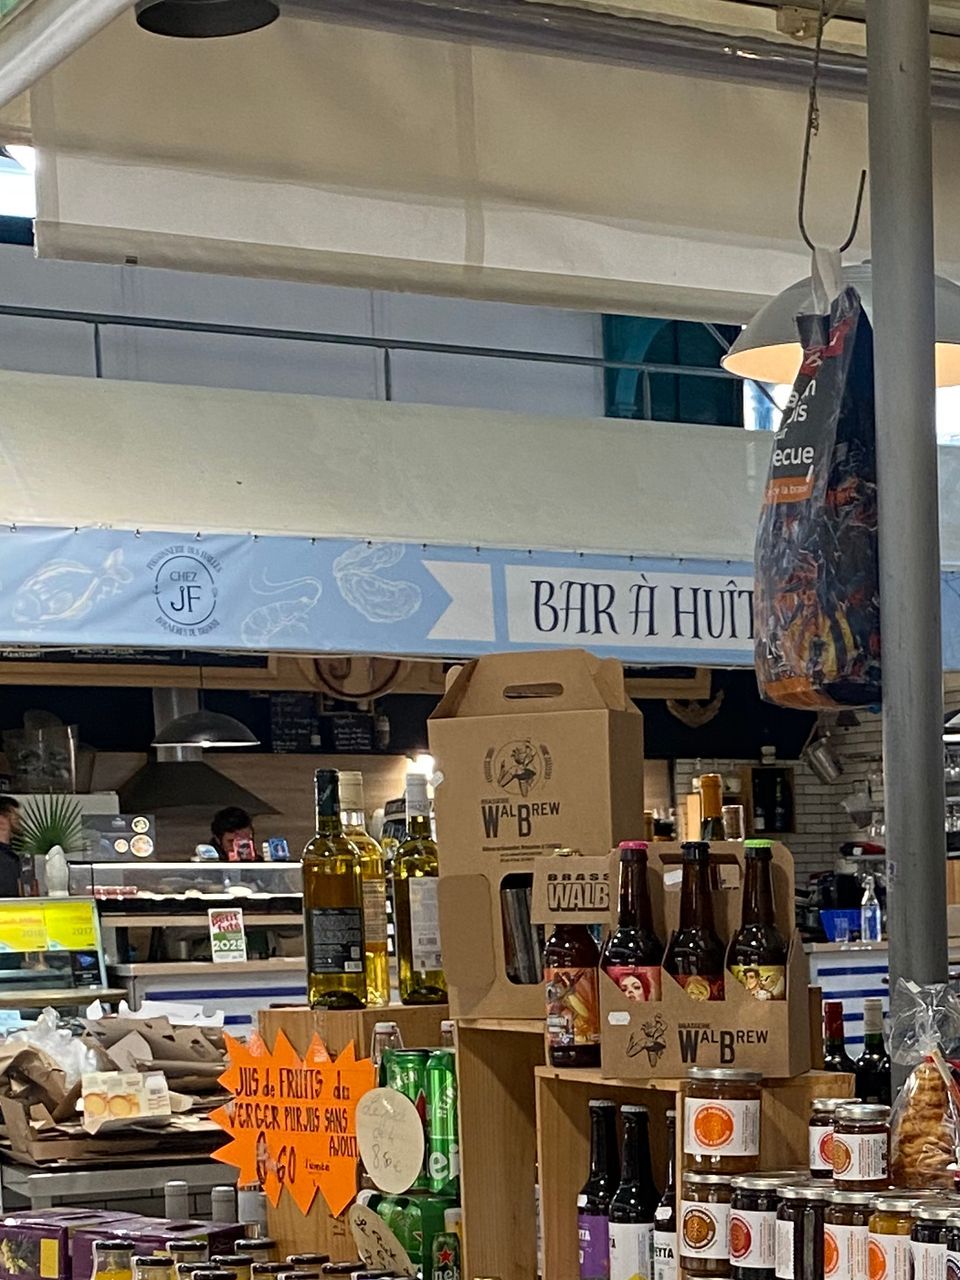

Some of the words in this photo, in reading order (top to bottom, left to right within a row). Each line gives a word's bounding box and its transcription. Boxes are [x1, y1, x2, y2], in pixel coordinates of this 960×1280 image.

[169, 570, 198, 583] CHEZ
[170, 585, 202, 613] JF
[530, 580, 620, 635] BAR
[628, 573, 660, 637] À
[213, 939, 245, 951] 2025
[235, 1067, 259, 1098] JUS
[262, 1068, 276, 1099] de
[279, 1067, 324, 1100] FRUITS
[333, 1070, 350, 1101] du
[228, 1102, 281, 1131] VERGER
[324, 1107, 348, 1134] SANS
